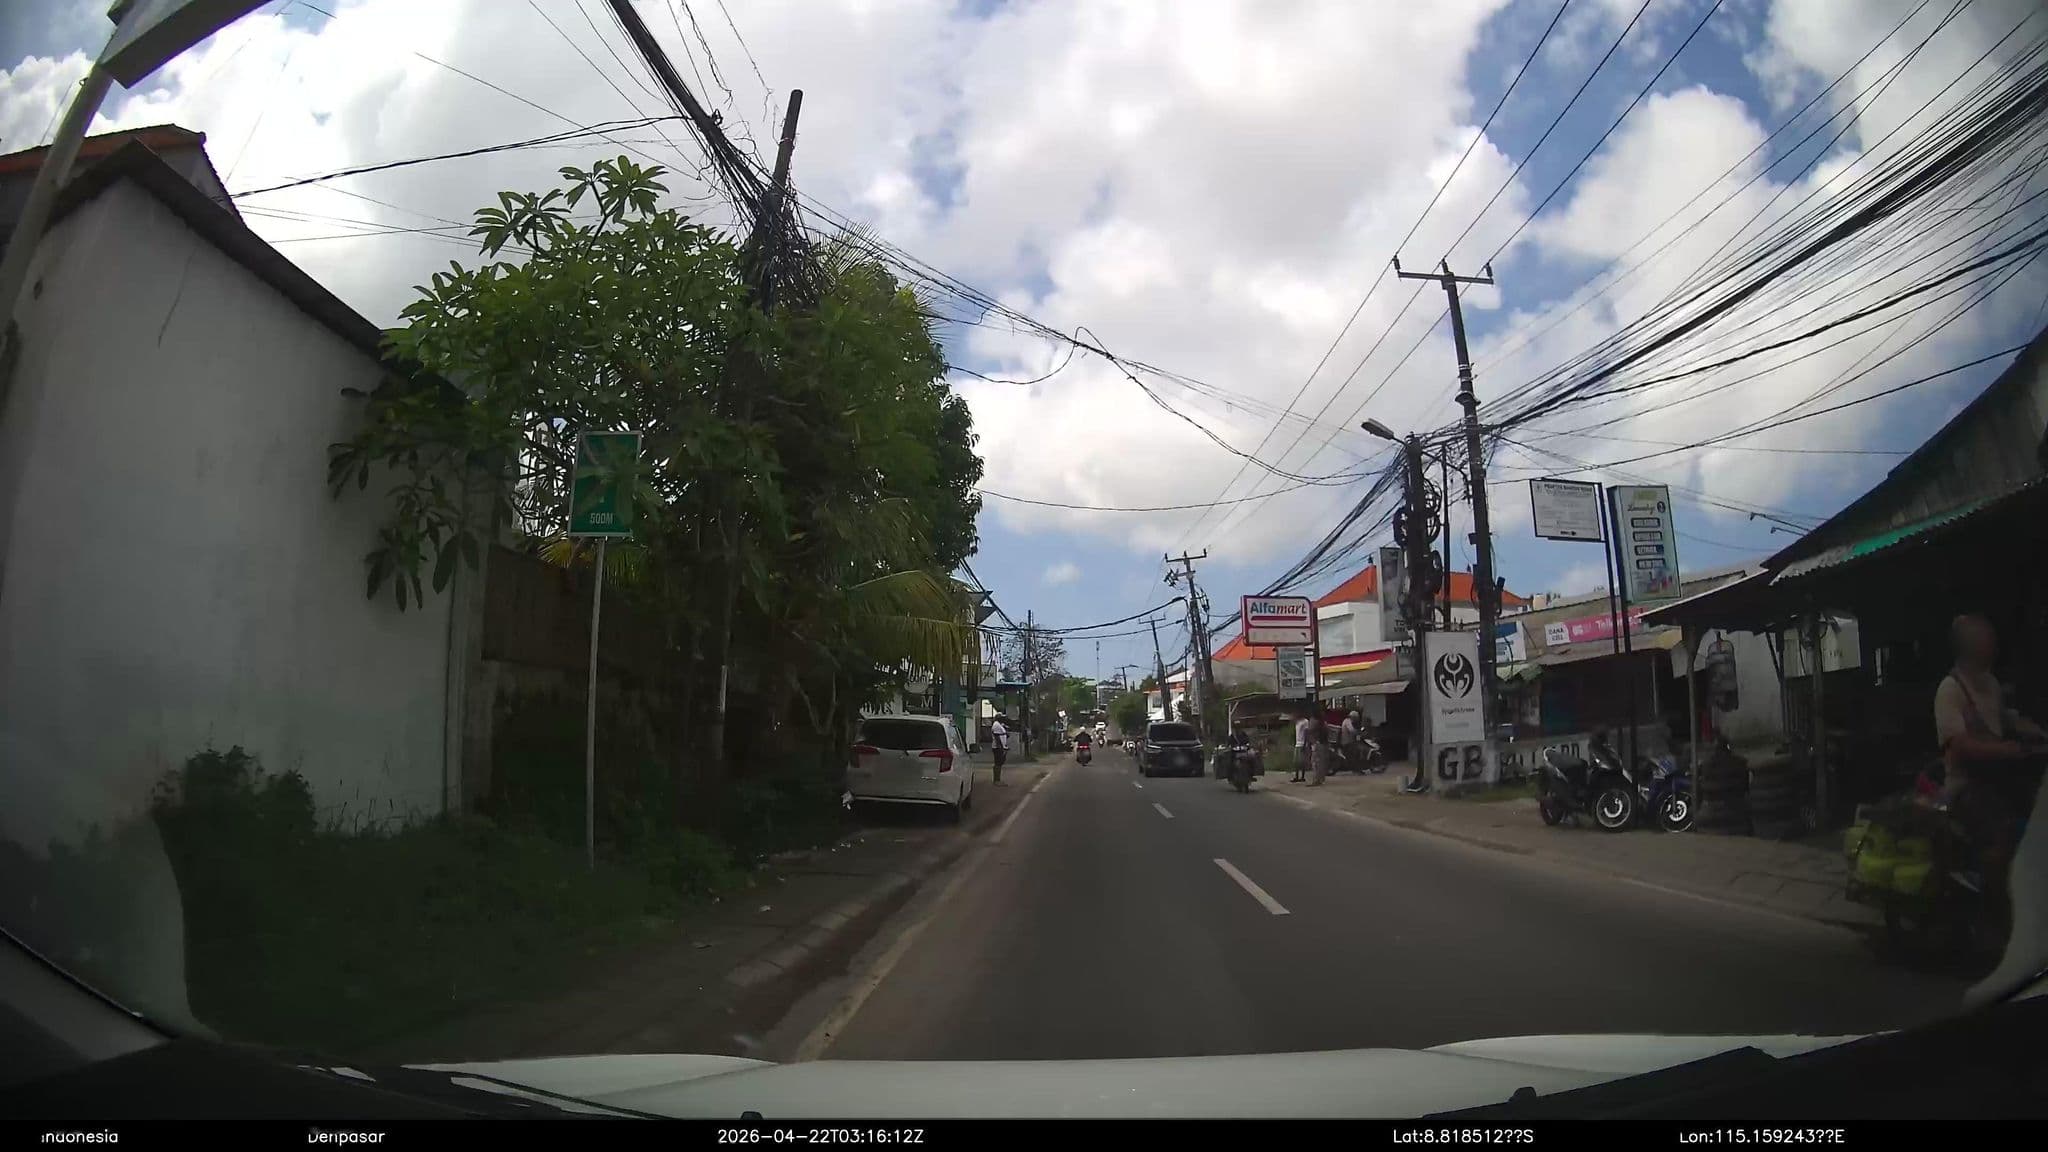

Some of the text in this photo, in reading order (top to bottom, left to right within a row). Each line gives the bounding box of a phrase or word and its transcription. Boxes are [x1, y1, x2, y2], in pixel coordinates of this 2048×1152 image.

[590, 512, 614, 525] 500M
[1250, 601, 1307, 615] Alfamart
[1438, 744, 1483, 781] GB
